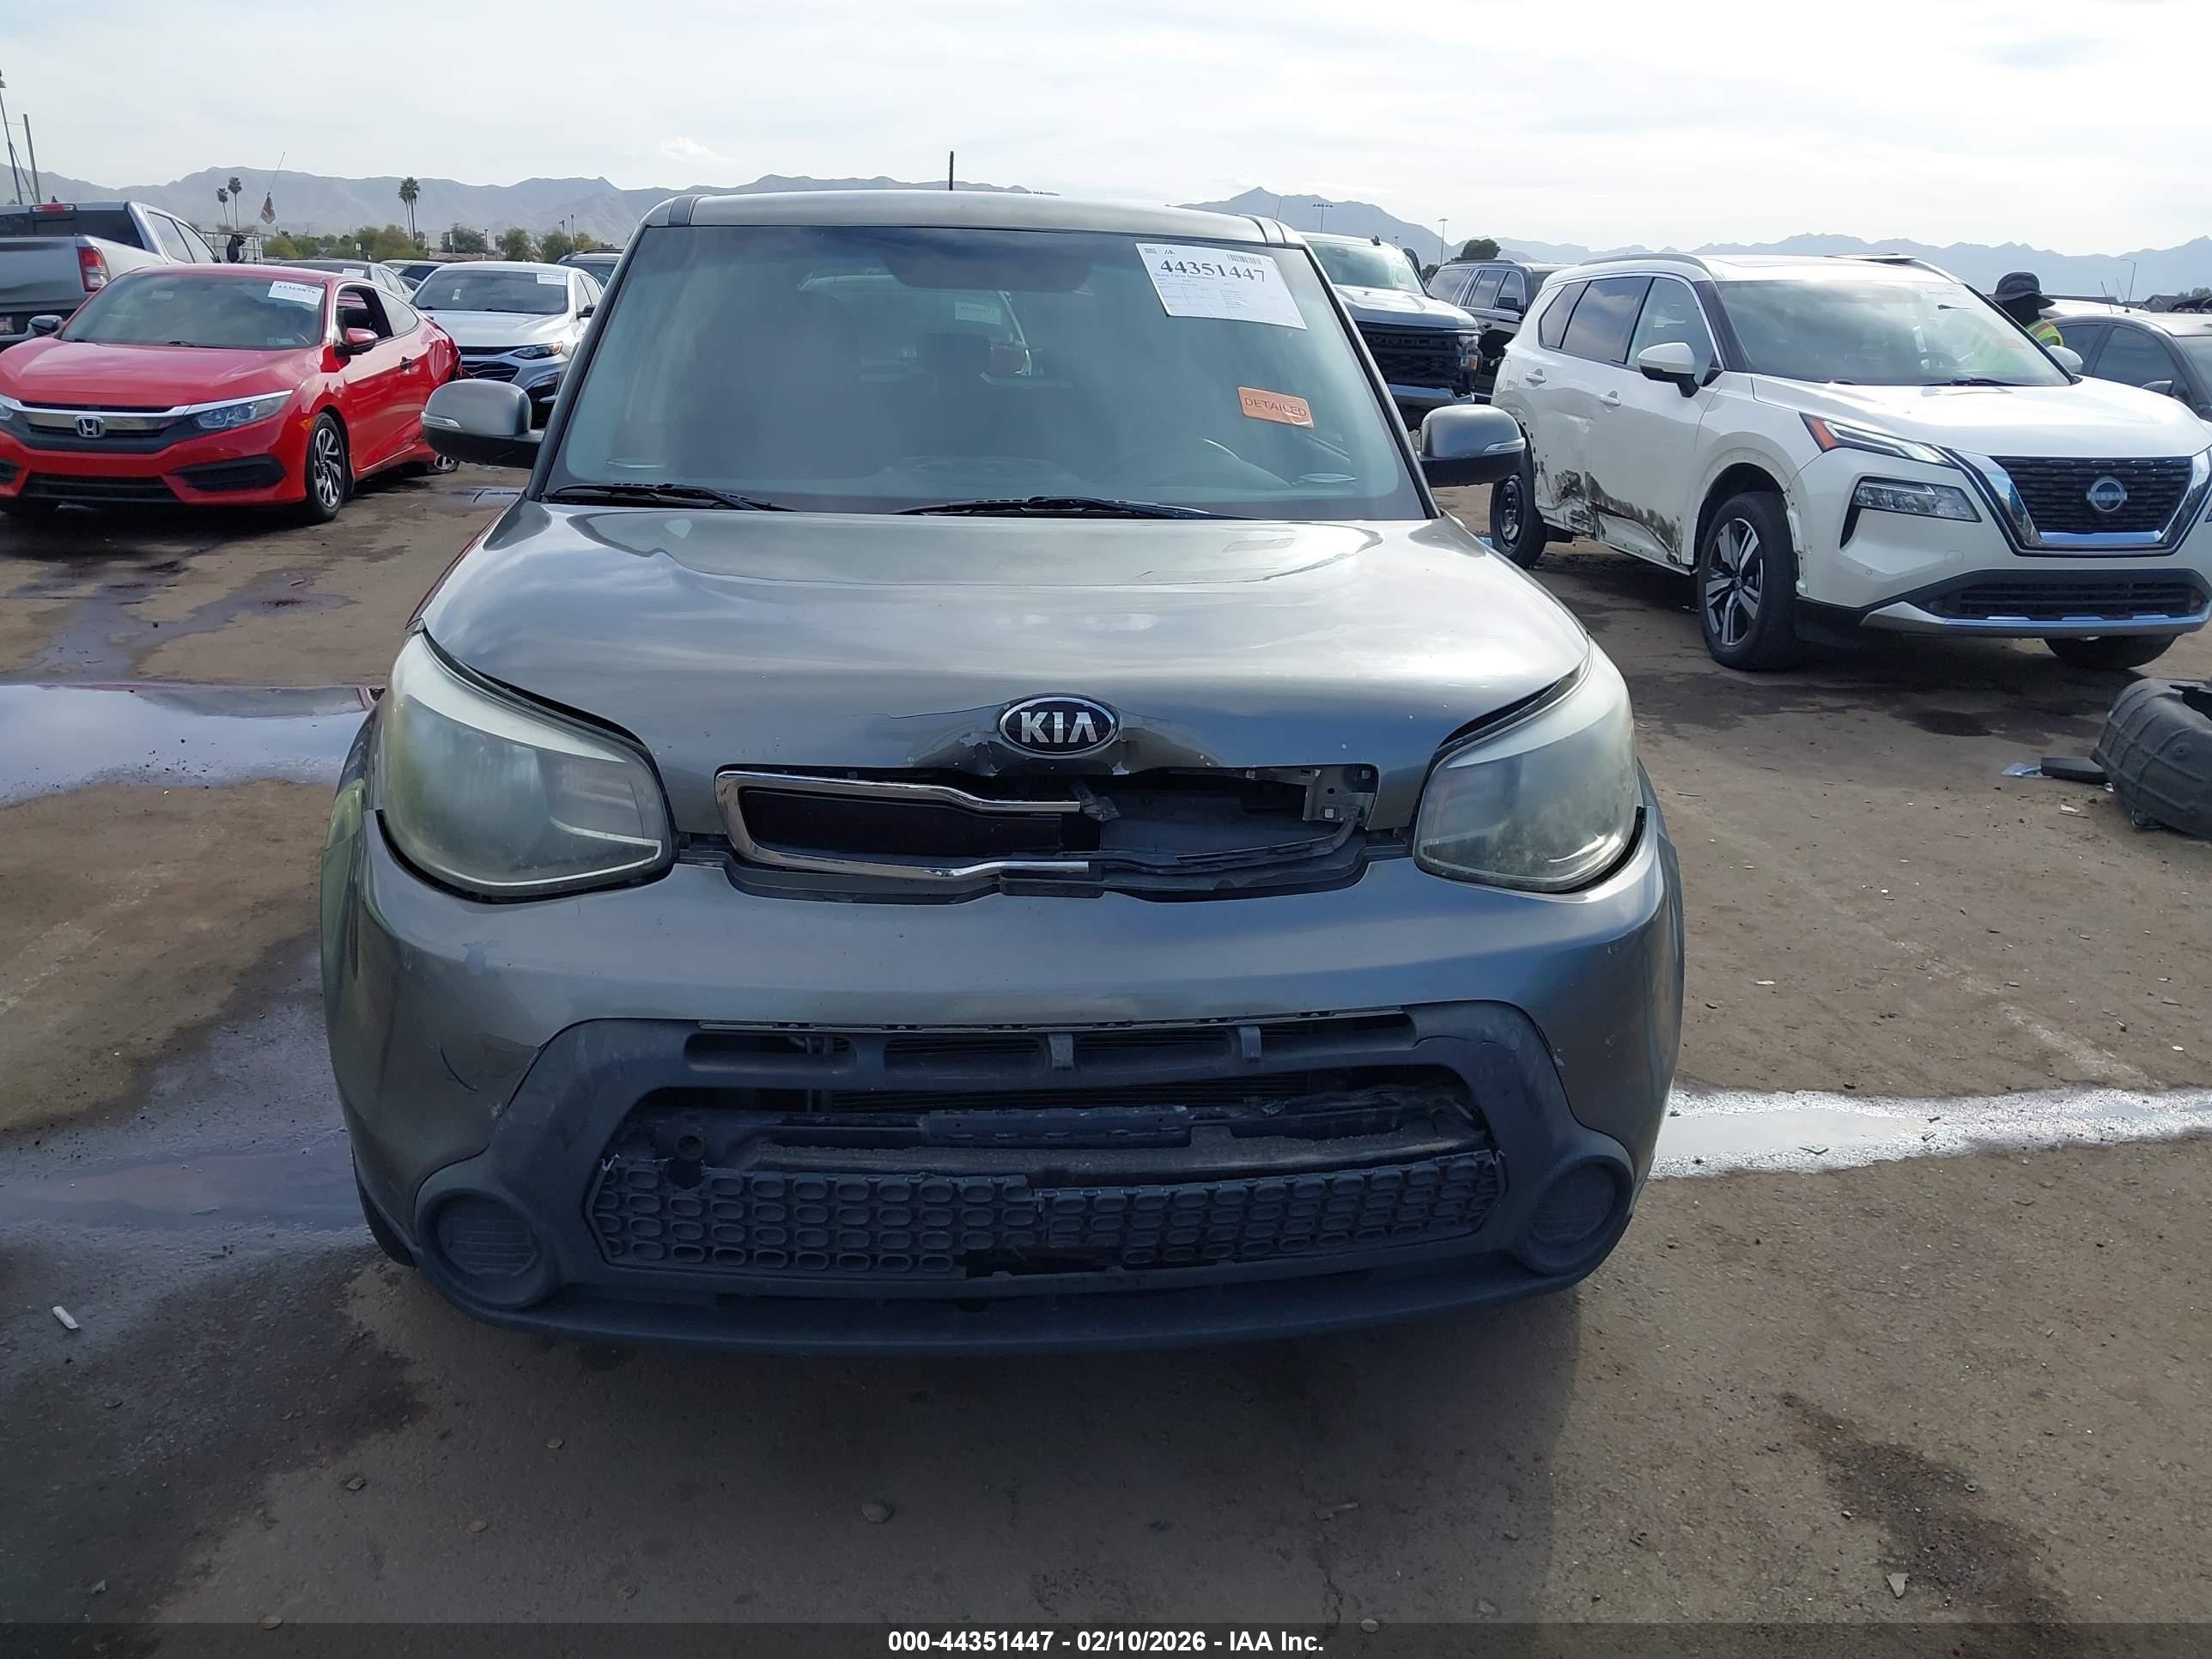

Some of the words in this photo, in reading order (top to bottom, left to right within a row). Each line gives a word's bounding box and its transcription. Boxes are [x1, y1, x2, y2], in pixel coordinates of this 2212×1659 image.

[1160, 259, 1265, 282] 44351447
[1244, 398, 1307, 416] DETAILED
[1019, 711, 1098, 744] KIA
